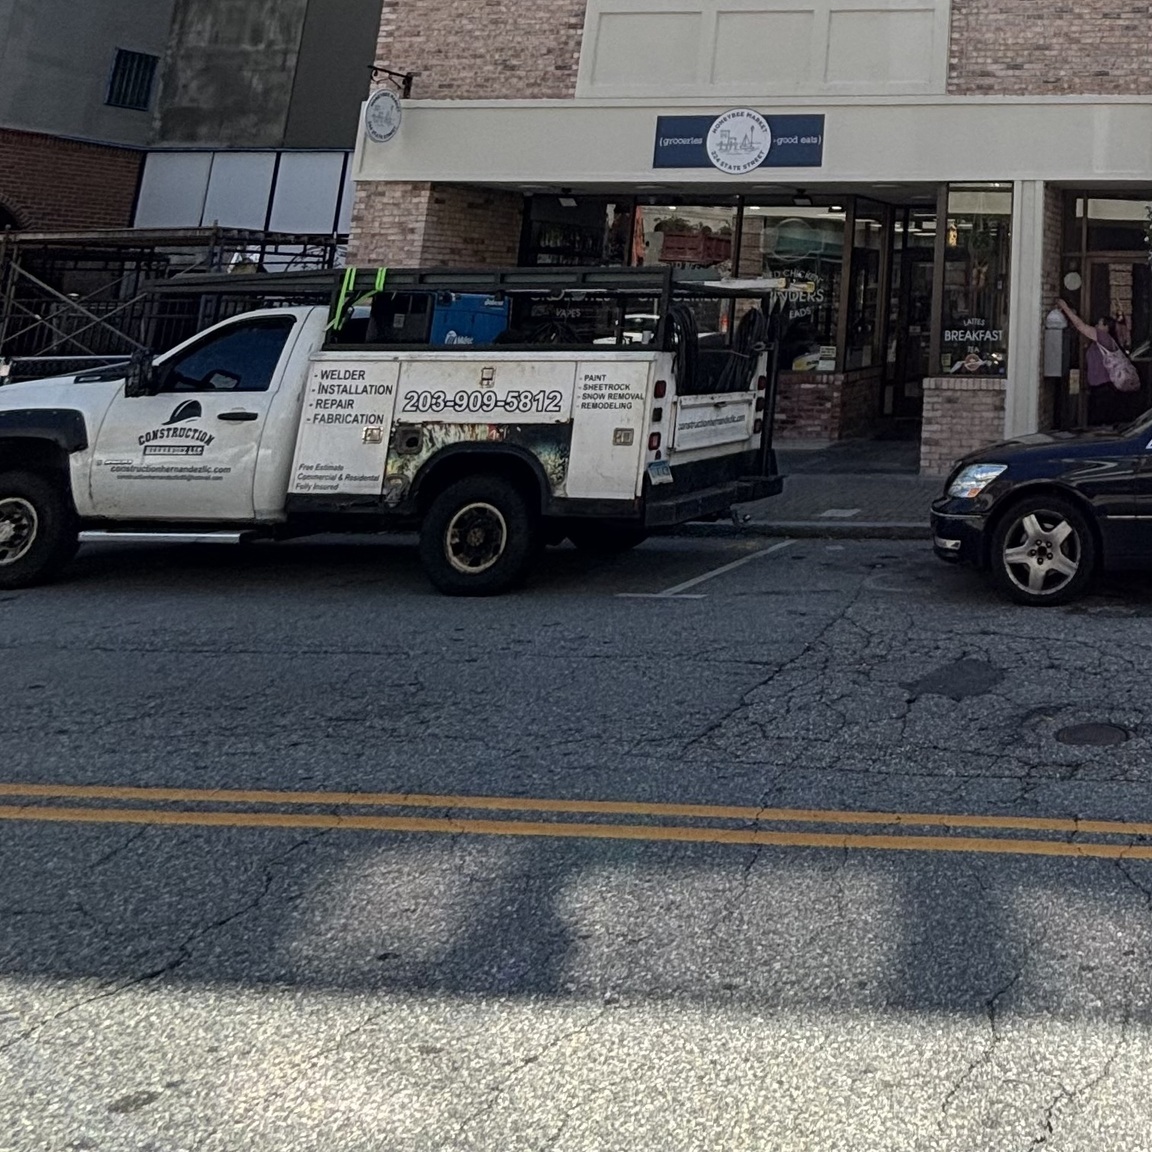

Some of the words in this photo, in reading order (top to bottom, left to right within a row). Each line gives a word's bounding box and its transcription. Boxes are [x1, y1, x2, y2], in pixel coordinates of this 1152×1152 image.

[712, 111, 745, 134] HONEYBEE
[746, 112, 768, 133] MARKET
[711, 150, 720, 163] 224
[720, 161, 741, 171] STATE
[742, 150, 765, 170] STREET
[555, 308, 582, 318] VAPES
[944, 329, 1003, 341] BREAKFAST
[320, 369, 366, 381] WELDER
[584, 374, 606, 382] PAINT
[317, 383, 393, 395] INSTALLATION
[583, 383, 631, 391] SHEETROCK
[582, 392, 606, 400] SNOW
[607, 392, 644, 400] REMOVAL
[315, 399, 355, 409] REPAIR
[403, 390, 563, 413] 203-909-5812
[580, 401, 632, 410] REMODELING
[312, 413, 384, 424] FABRICATION
[138, 427, 215, 446] CONSTRUCTION
[298, 463, 314, 471] Free
[297, 473, 337, 481] Commercial
